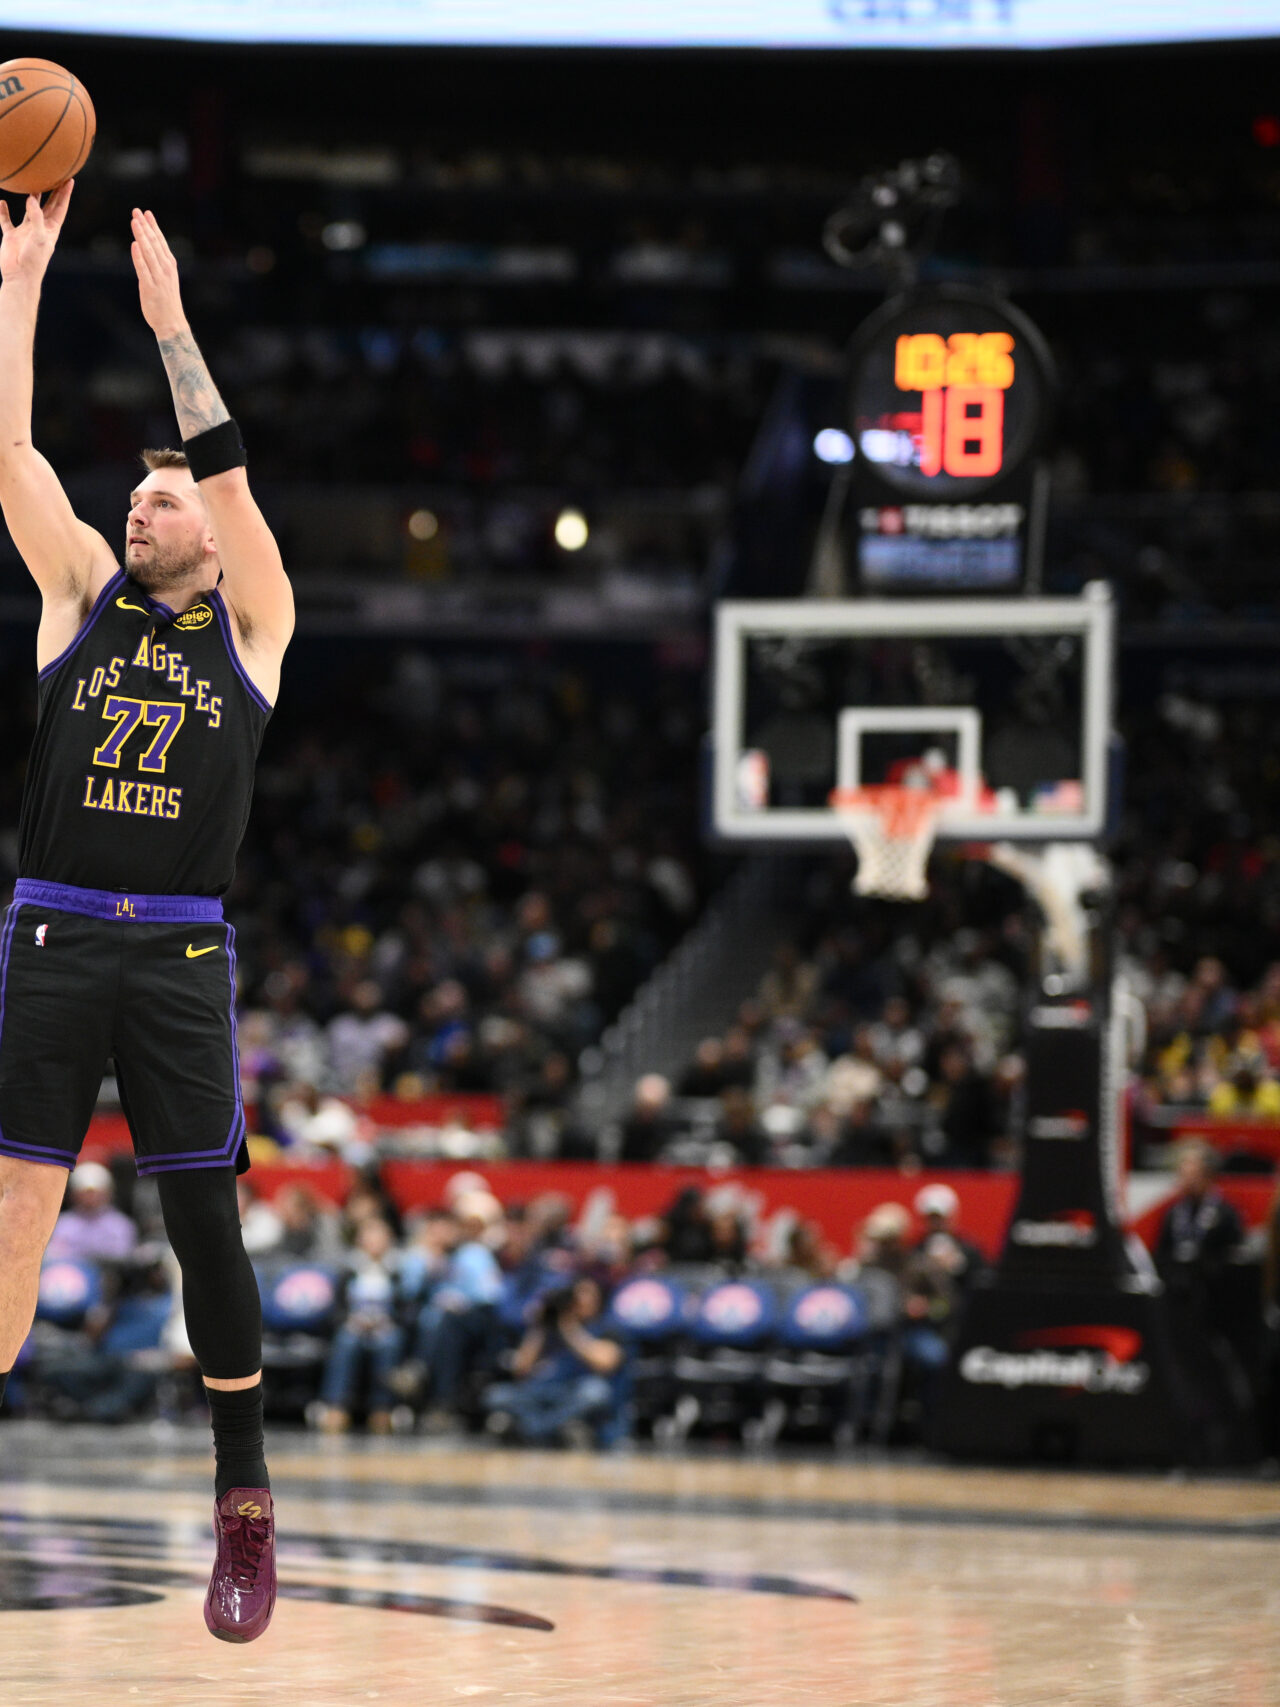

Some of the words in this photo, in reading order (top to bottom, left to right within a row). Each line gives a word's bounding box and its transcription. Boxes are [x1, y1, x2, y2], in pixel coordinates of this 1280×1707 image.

[920, 386, 1005, 477] 18
[72, 655, 127, 711] LOS
[93, 695, 186, 773] 77
[82, 776, 183, 819] LAKERS
[116, 898, 135, 917] LAL
